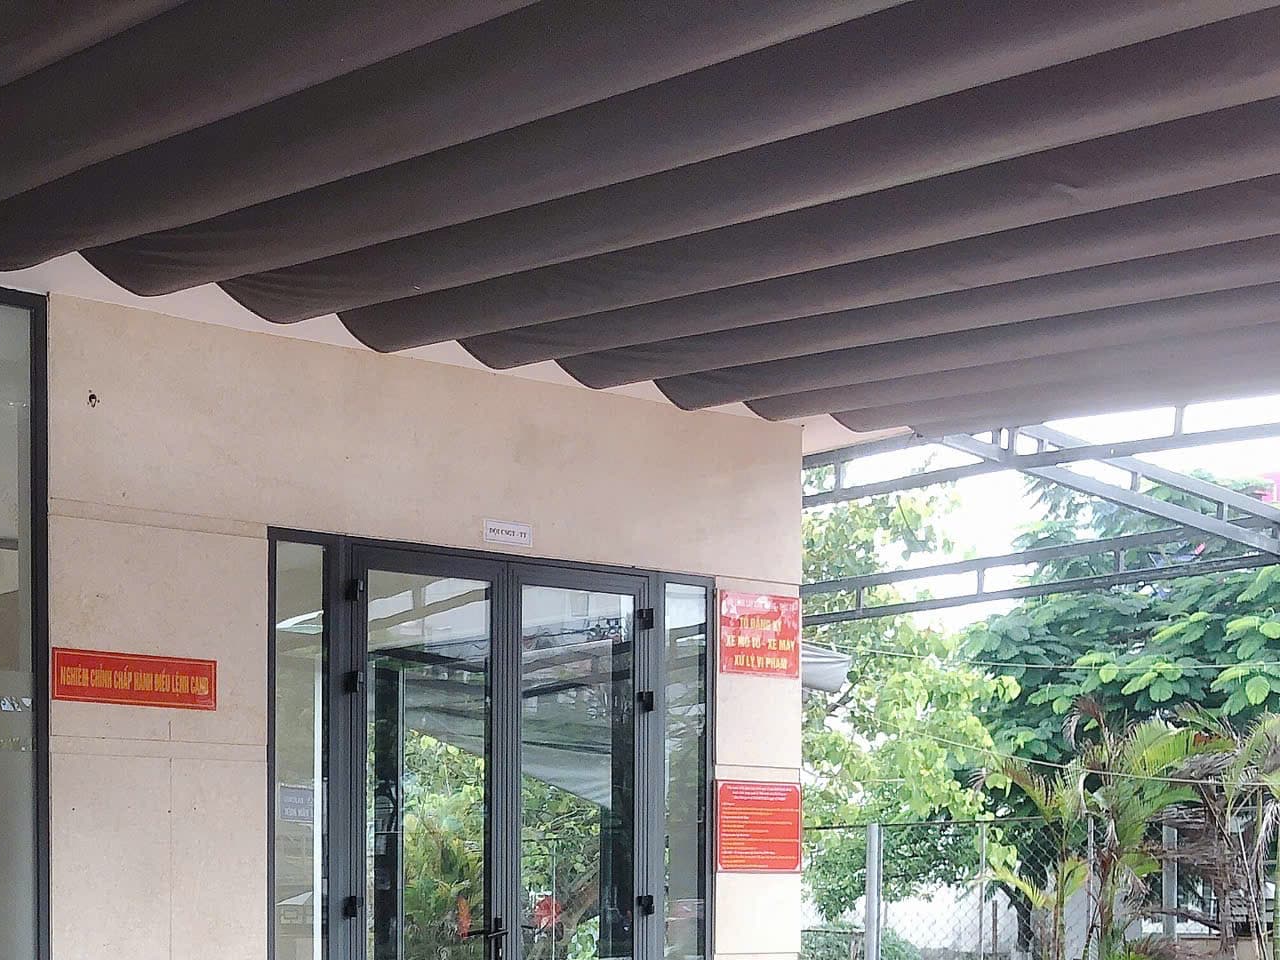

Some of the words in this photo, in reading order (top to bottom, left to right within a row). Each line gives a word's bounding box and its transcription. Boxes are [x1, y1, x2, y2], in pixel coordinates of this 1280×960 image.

[767, 638, 778, 650] XE
[60, 663, 89, 688] NGHIÊM
[113, 664, 133, 690] CHẤP
